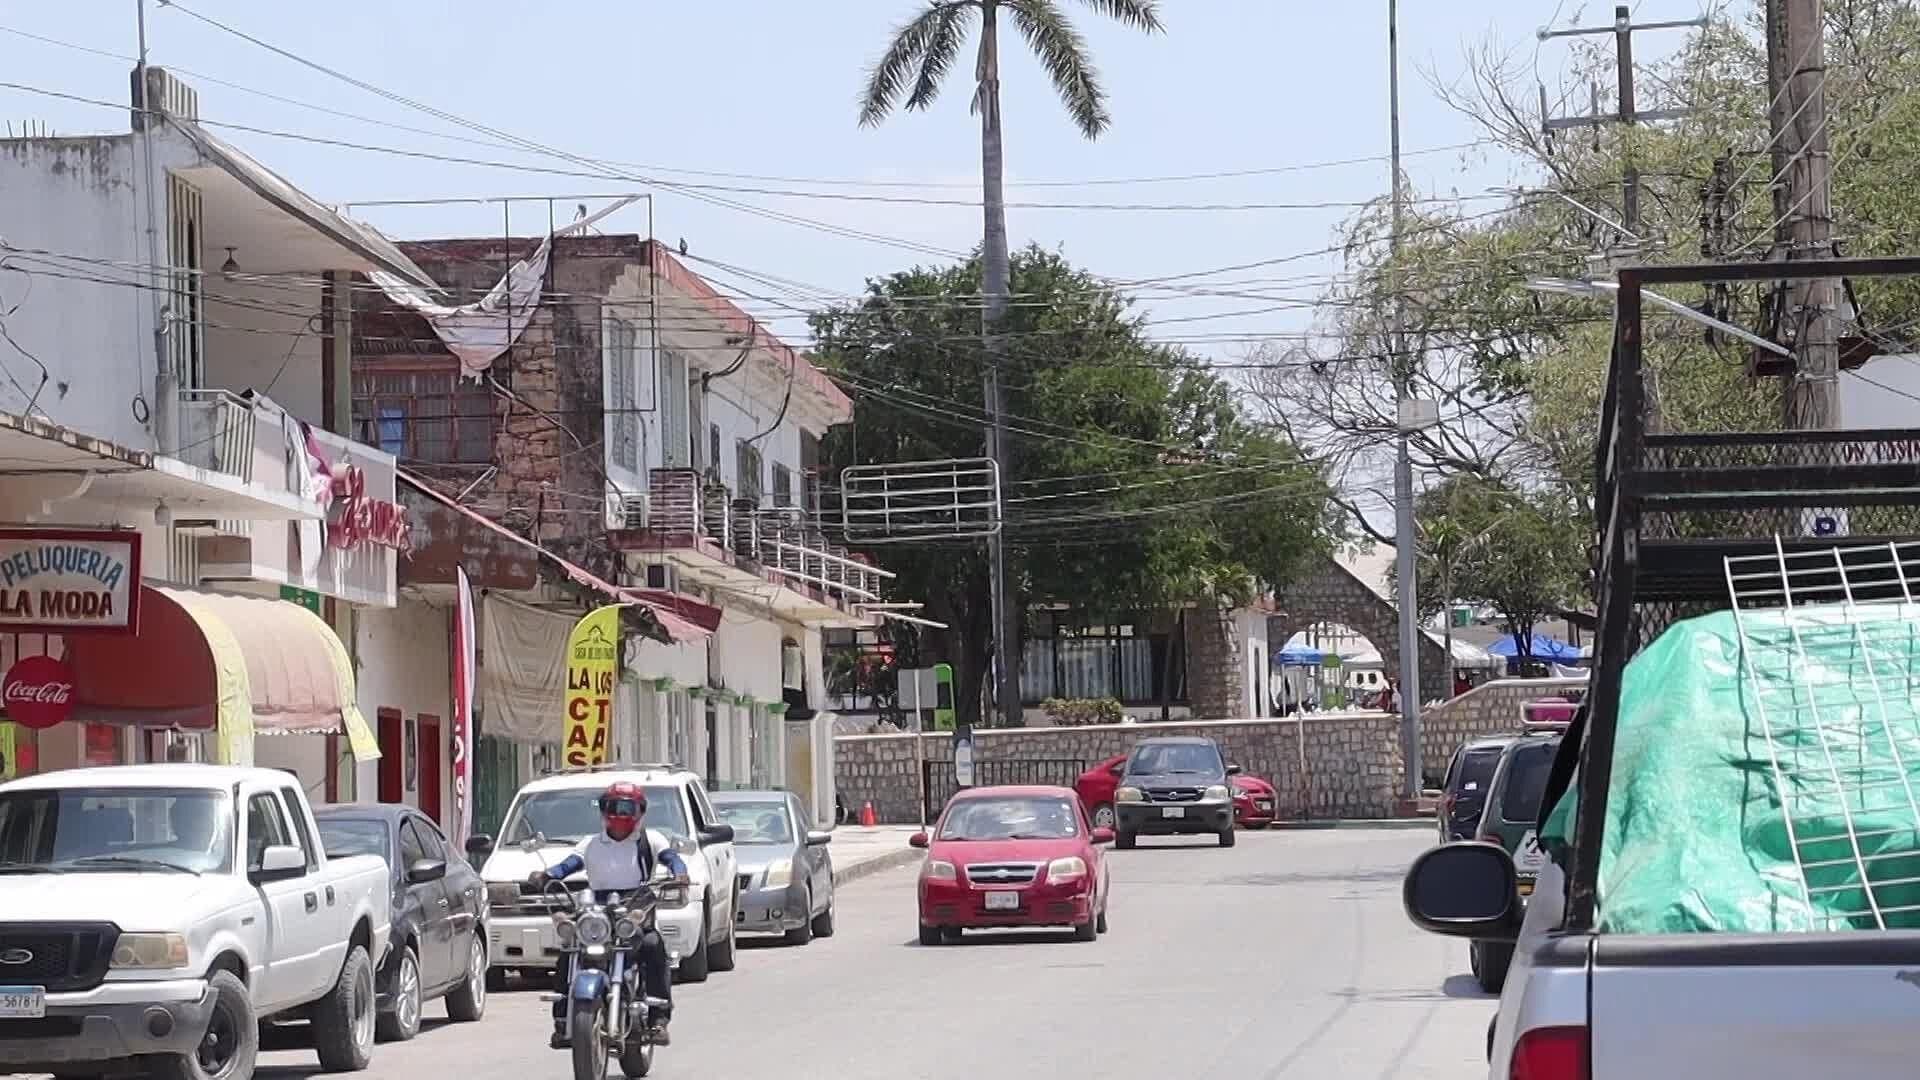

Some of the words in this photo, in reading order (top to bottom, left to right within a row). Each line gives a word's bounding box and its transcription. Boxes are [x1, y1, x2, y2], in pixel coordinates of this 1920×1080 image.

[1, 545, 124, 591] PELUQUERIA
[0, 589, 33, 618] LA
[40, 589, 113, 619] MODA
[568, 667, 590, 690] LA
